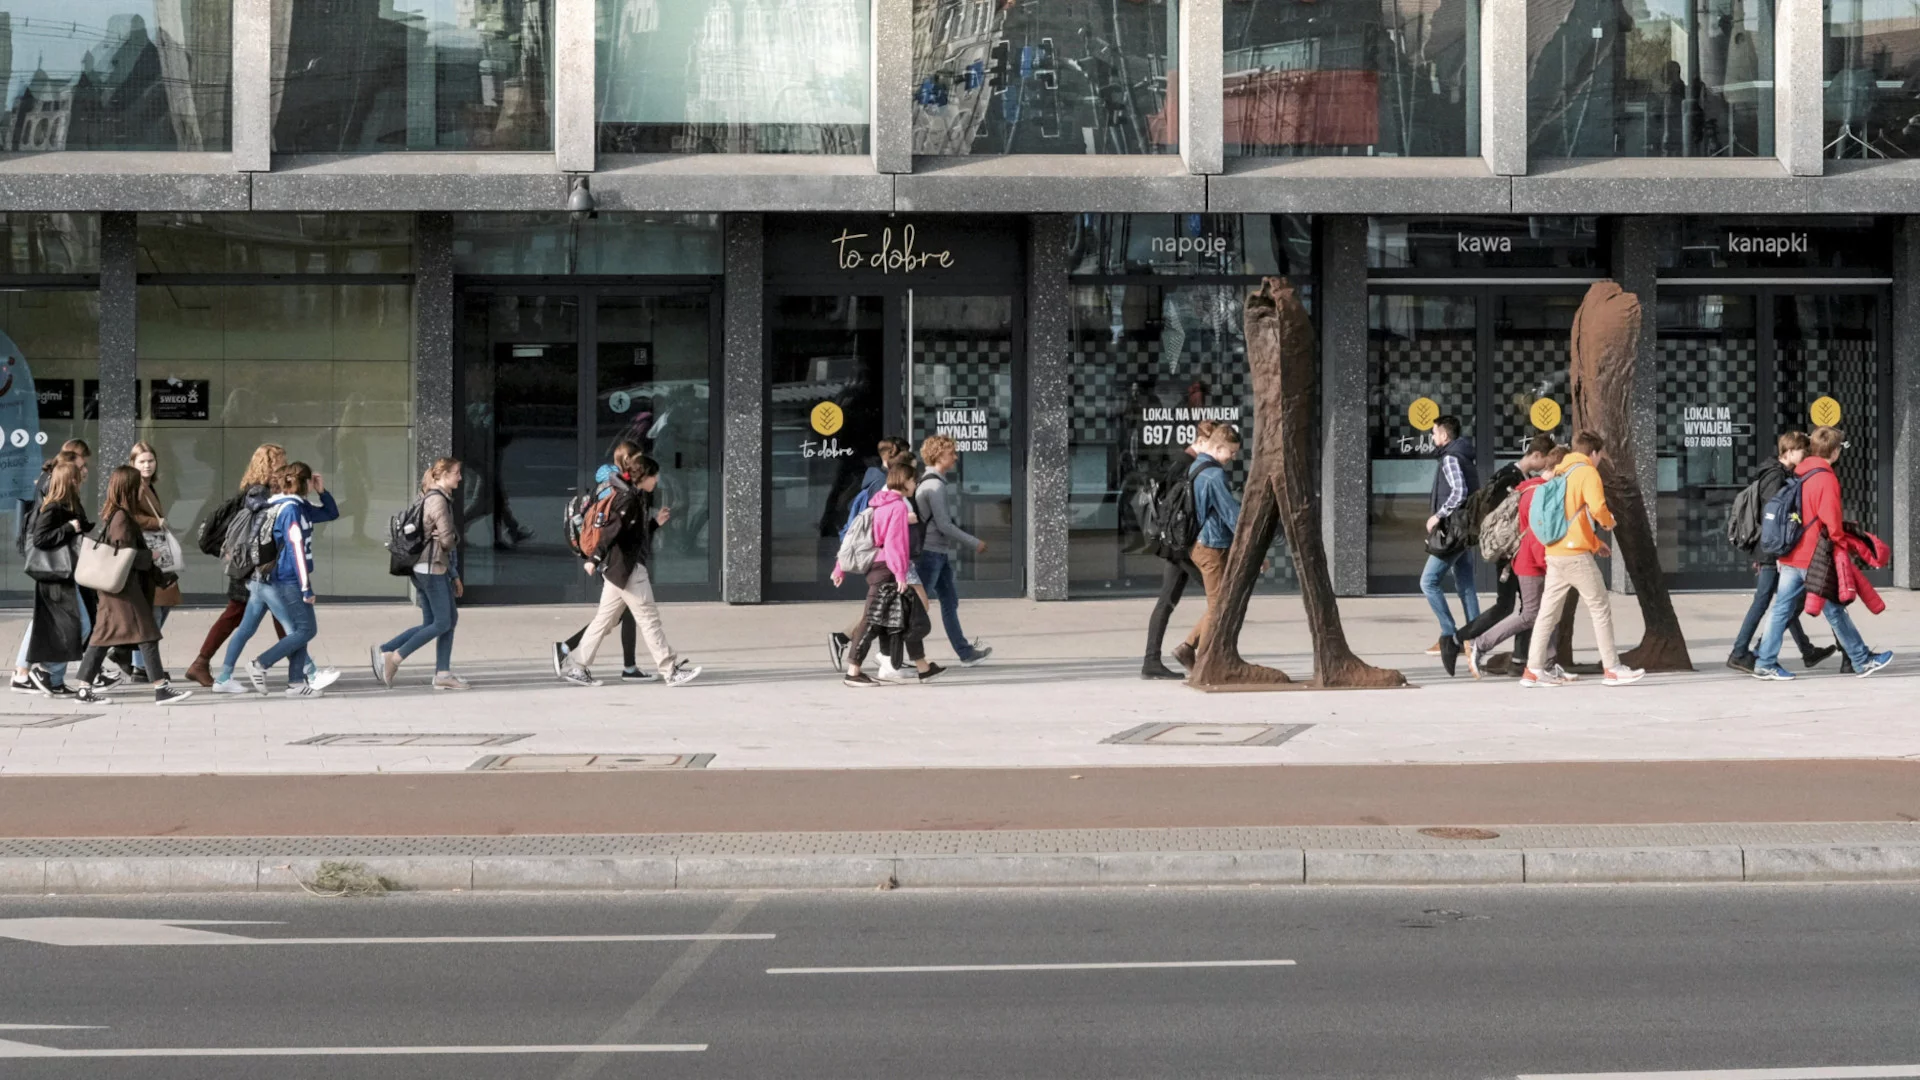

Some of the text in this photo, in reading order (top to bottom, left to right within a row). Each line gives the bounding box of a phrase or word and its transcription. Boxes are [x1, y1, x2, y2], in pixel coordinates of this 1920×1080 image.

[1151, 232, 1227, 257] napoje
[1458, 231, 1512, 252] kawa
[1728, 231, 1808, 258] kanapki
[831, 224, 954, 275] to dobre
[159, 395, 187, 404] SWECO
[936, 410, 987, 425] LOKAL NA
[1142, 407, 1239, 421] LOKAL NA WYNAJEM
[1684, 406, 1731, 420] LOKAL NA
[936, 425, 988, 439] WYNAJEM
[1143, 424, 1197, 445] 697 69
[1684, 421, 1732, 435] WYNAJEM
[800, 438, 854, 459] to dobre
[971, 440, 988, 452] 053
[1396, 434, 1415, 454] to
[1684, 436, 1732, 447] 697 690 053
